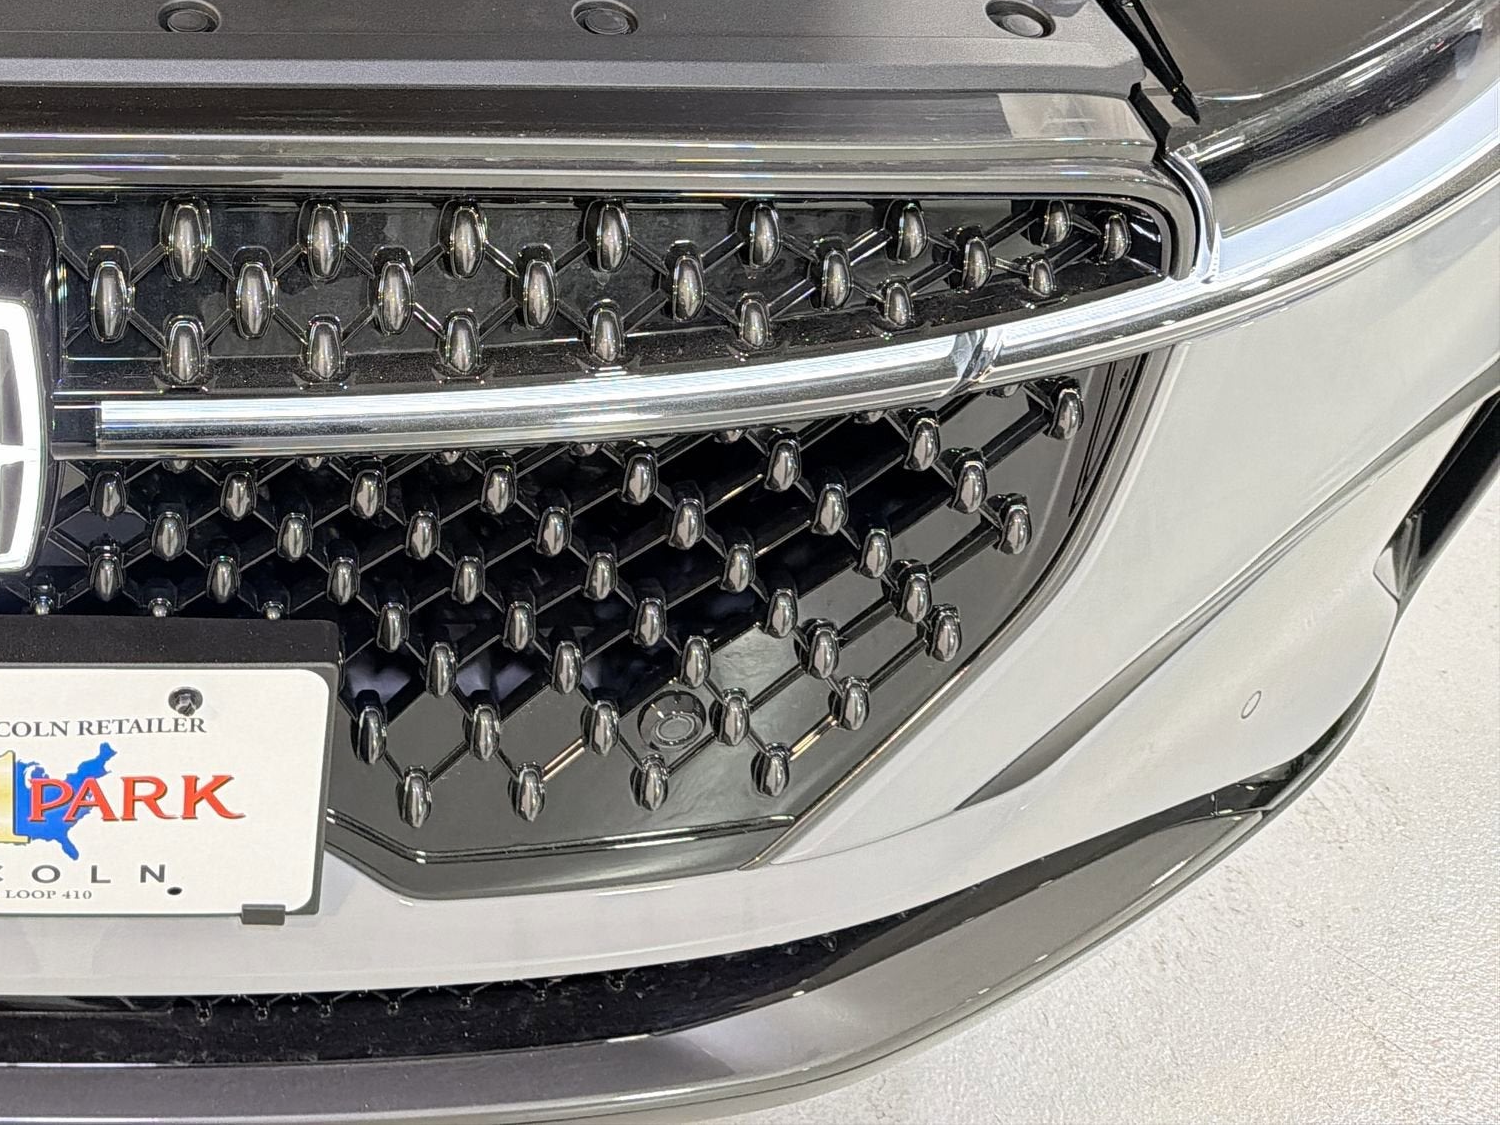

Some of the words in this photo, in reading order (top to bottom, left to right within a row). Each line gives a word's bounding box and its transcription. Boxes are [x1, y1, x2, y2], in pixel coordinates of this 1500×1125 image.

[77, 717, 207, 736] RETAILER
[28, 775, 246, 822] PARK
[5, 889, 57, 900] LOOP
[62, 890, 93, 900] 410
